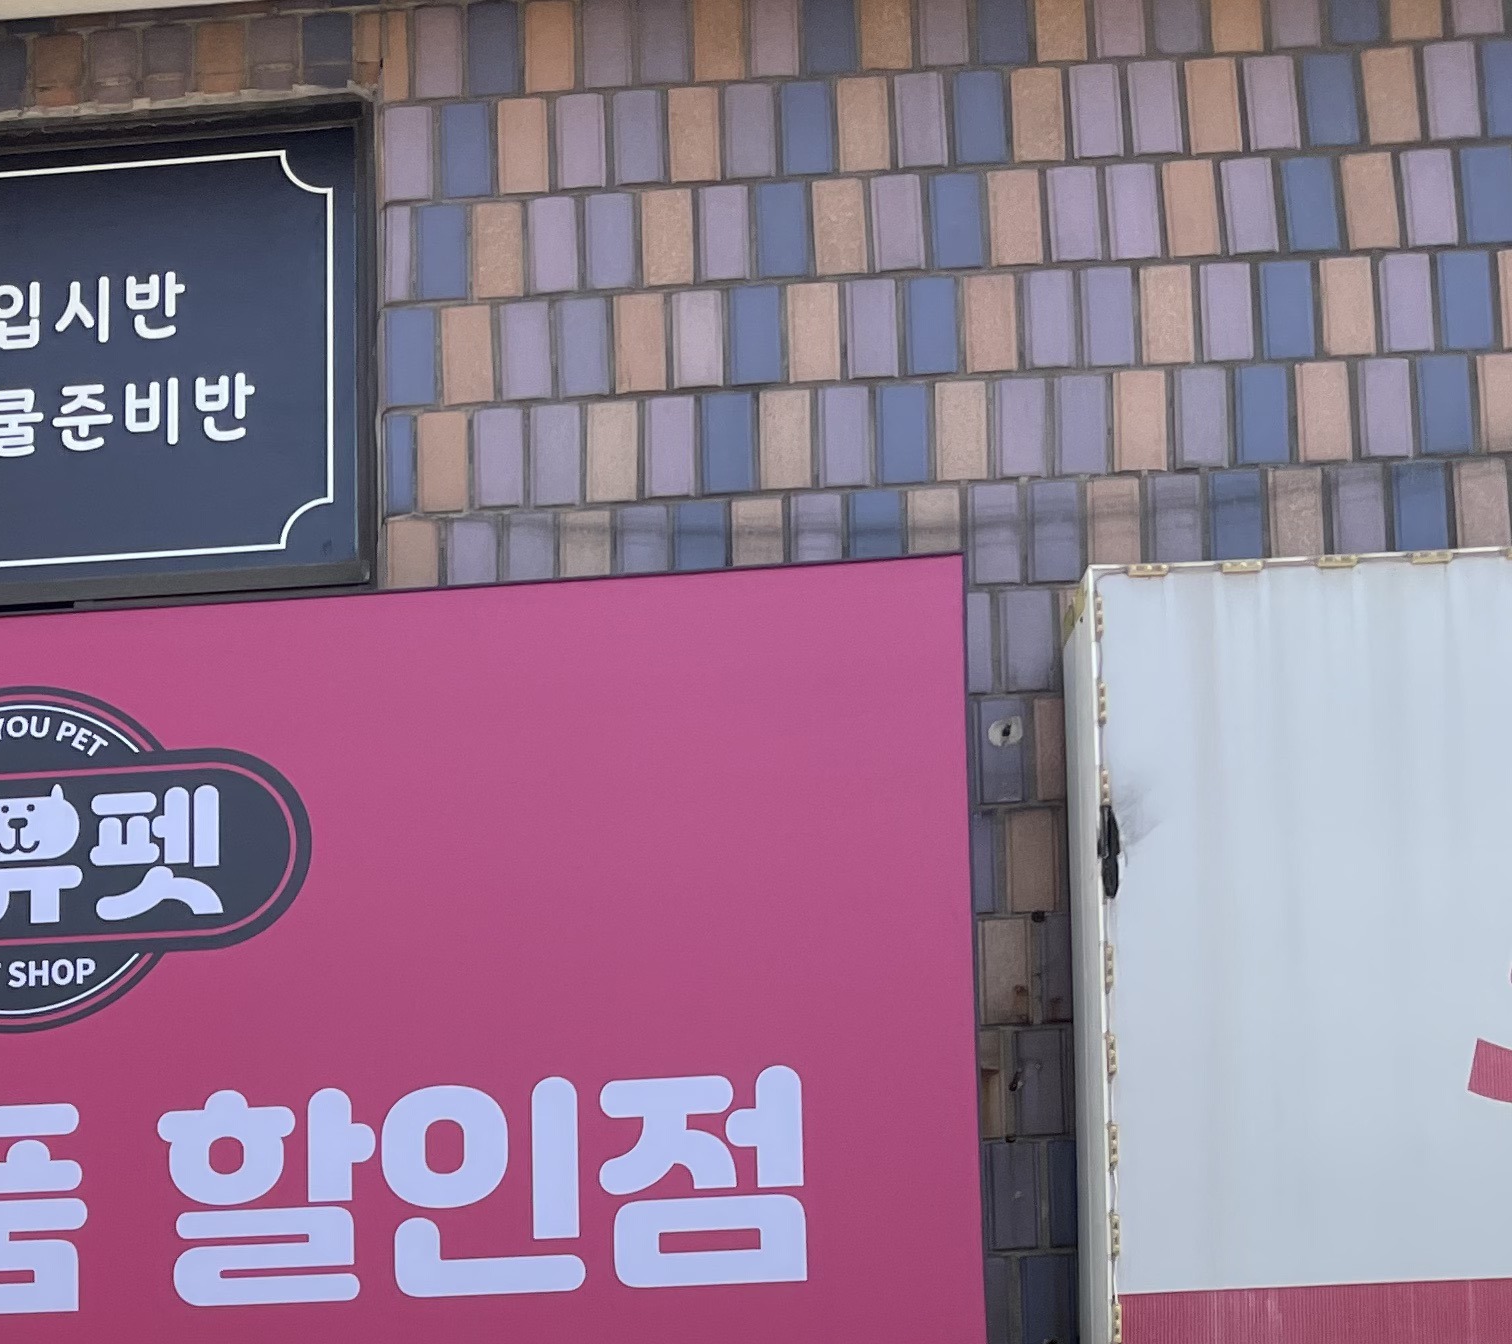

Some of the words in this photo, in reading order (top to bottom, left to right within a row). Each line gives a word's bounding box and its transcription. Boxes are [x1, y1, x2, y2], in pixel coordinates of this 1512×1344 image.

[55, 719, 110, 758] PET
[8, 957, 96, 989] SHOP
[157, 1064, 810, 1308] 할인점
